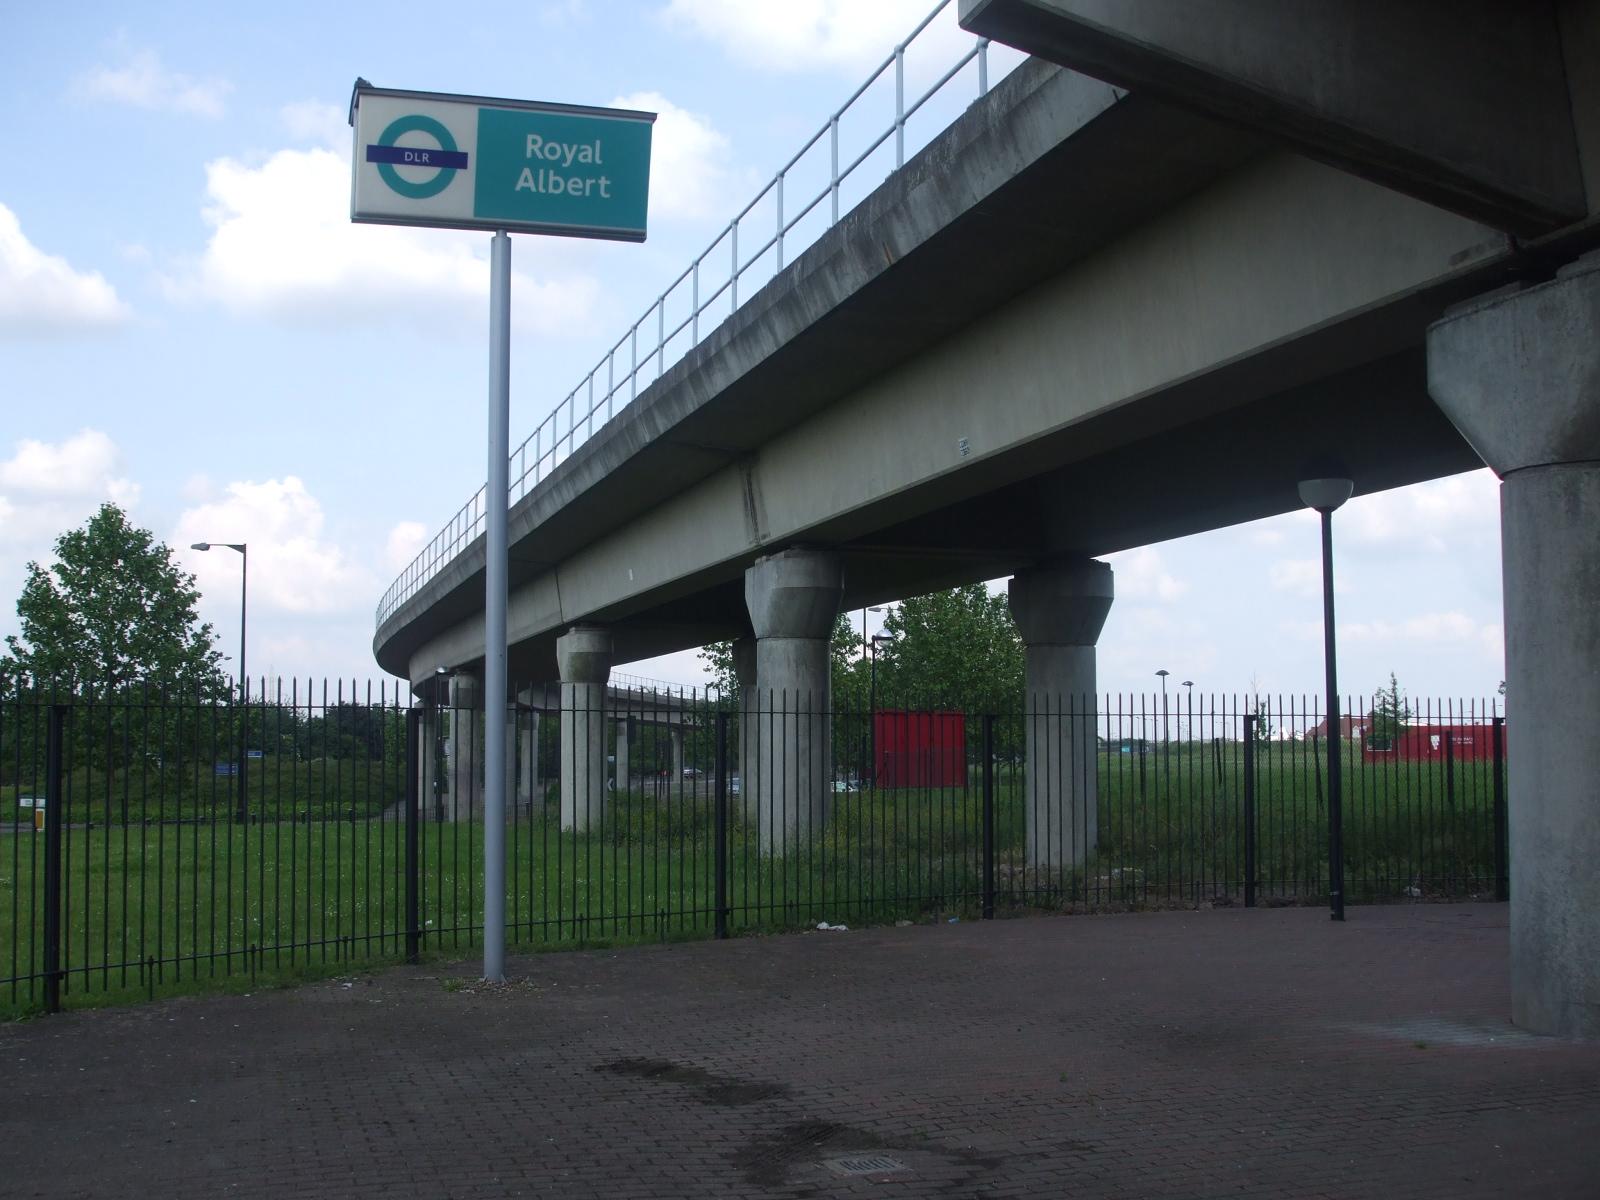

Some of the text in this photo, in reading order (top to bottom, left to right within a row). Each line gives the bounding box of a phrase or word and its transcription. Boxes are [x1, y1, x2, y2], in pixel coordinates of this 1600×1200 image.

[404, 151, 430, 164] DLR
[526, 134, 602, 166] Royal
[515, 168, 611, 198] Albert
